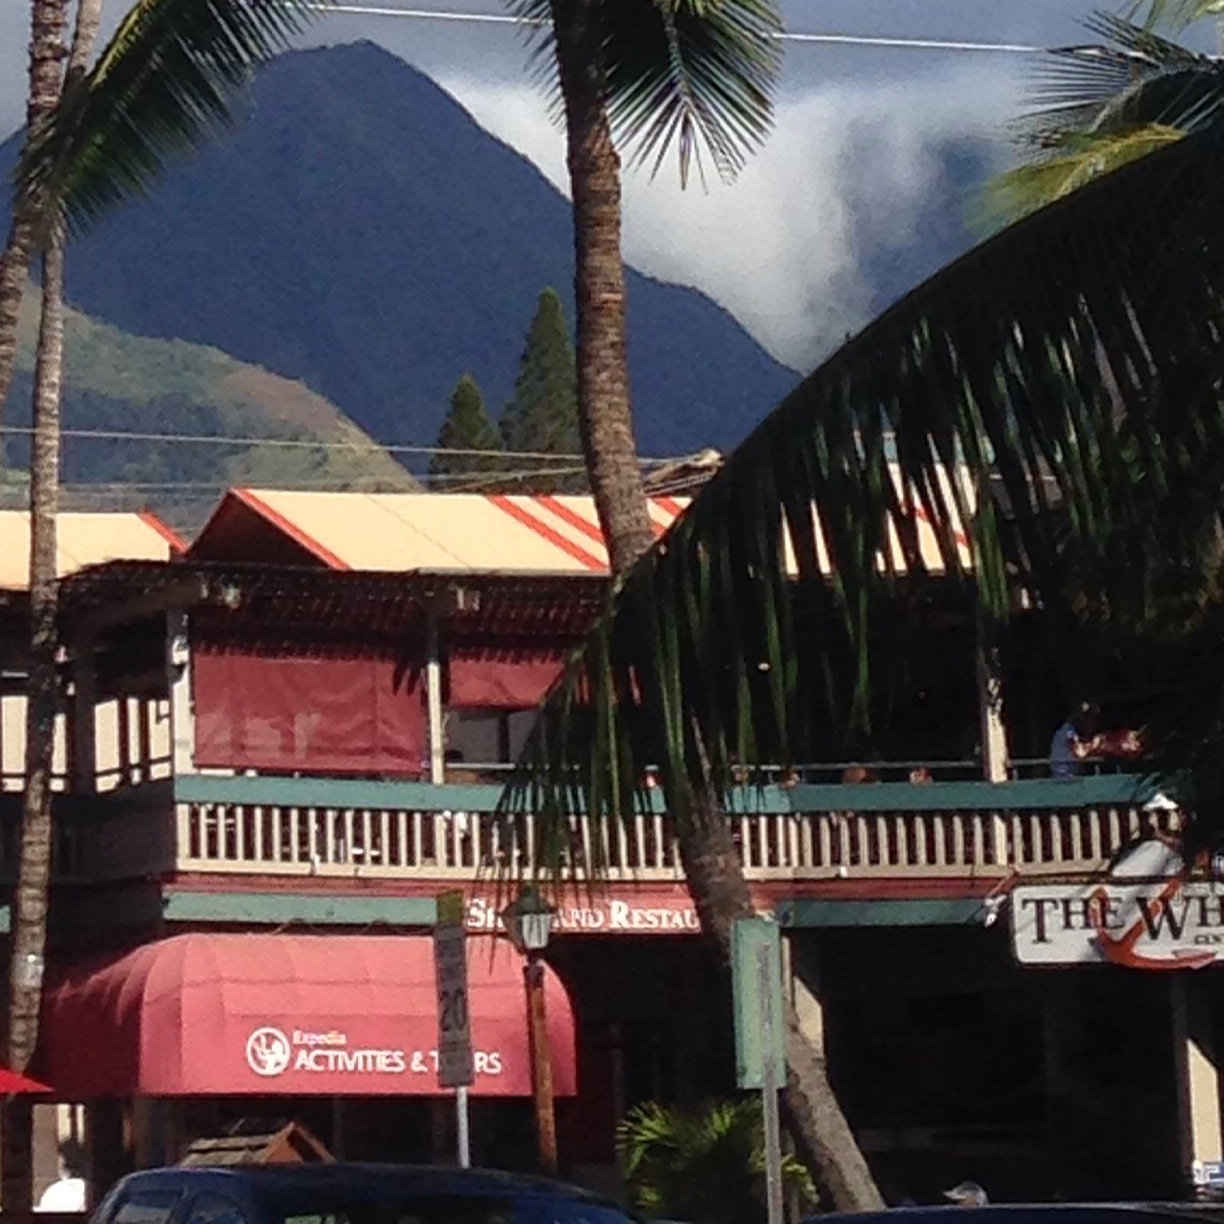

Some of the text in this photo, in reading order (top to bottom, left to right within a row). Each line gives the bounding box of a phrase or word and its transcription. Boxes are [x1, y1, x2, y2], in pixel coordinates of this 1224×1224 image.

[1022, 897, 1122, 944] THE
[292, 1029, 347, 1046] Expedia
[292, 1048, 502, 1075] ACTIVITIES & TRS
